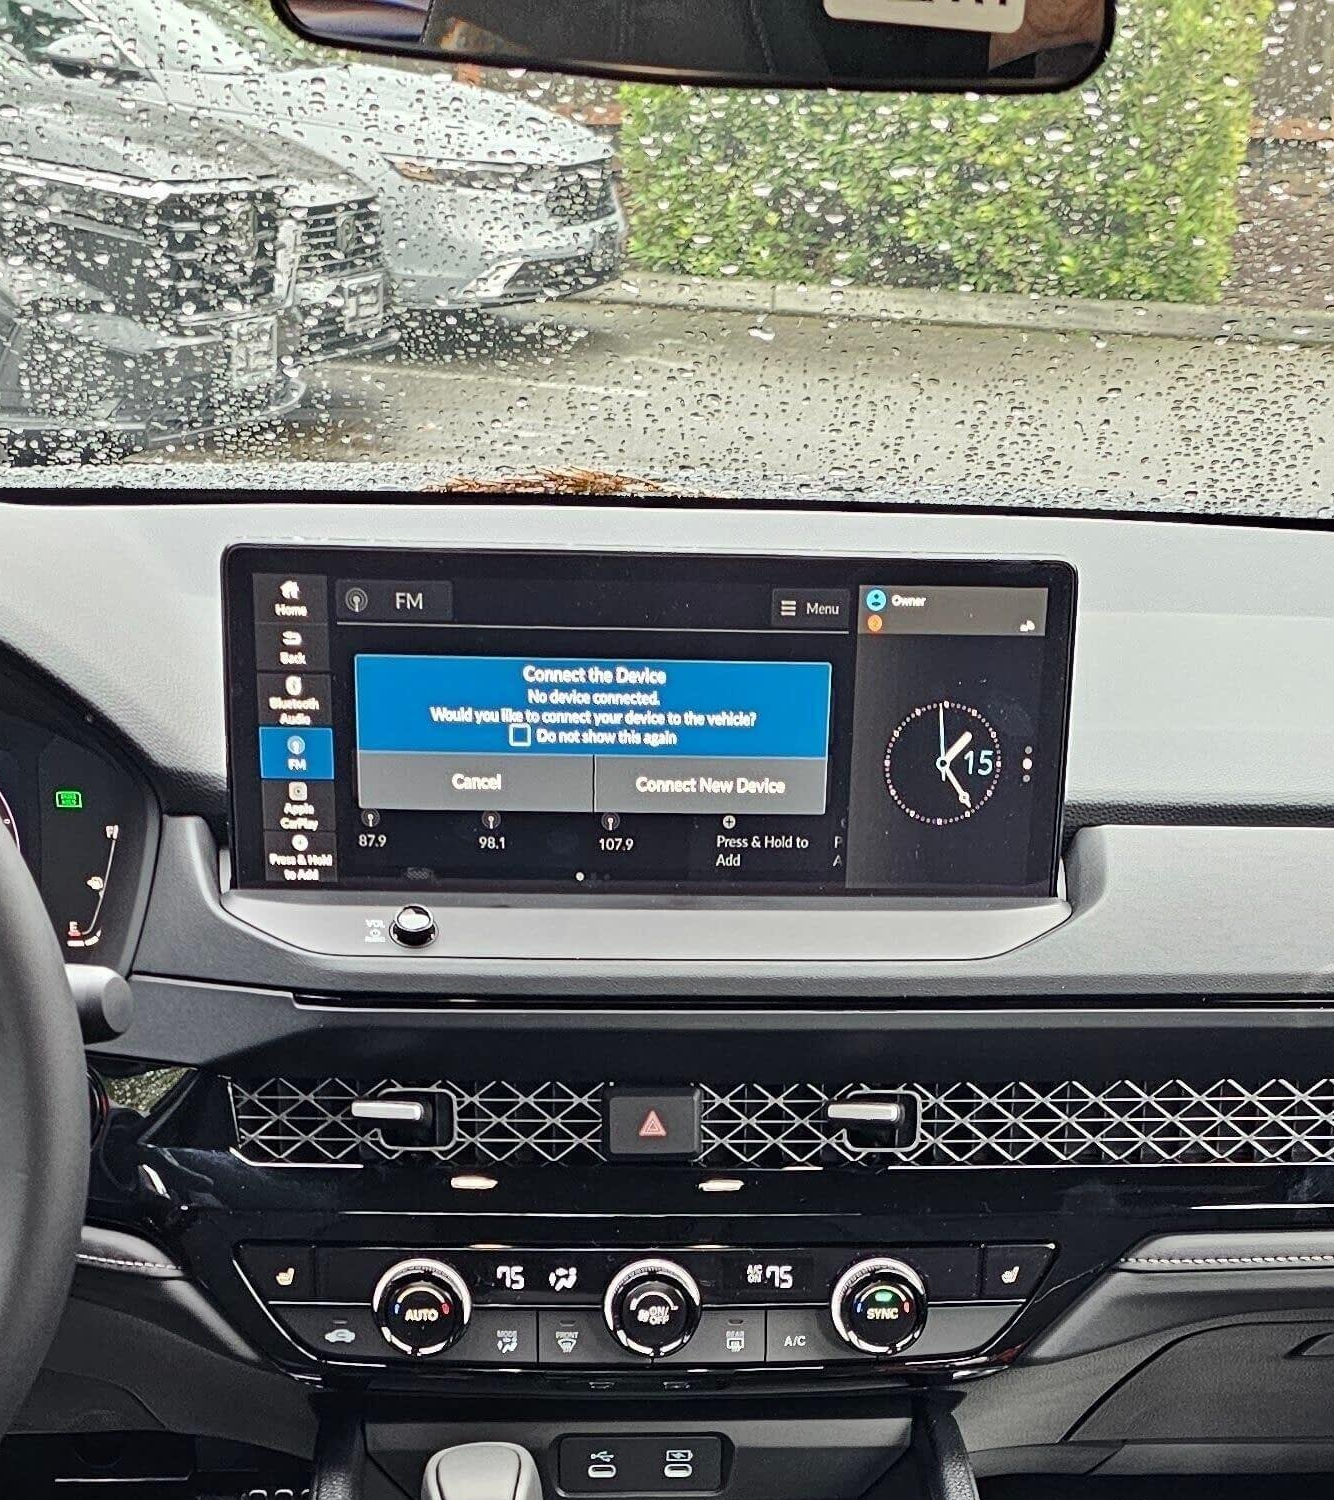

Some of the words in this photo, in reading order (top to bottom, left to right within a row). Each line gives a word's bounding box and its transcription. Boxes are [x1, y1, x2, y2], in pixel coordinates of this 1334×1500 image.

[396, 592, 424, 610] FM
[891, 594, 926, 607] Owner
[275, 604, 307, 617] Home
[806, 602, 839, 615] Menu
[280, 652, 306, 665] Back
[523, 665, 586, 683] Connect
[587, 666, 613, 684] the
[616, 666, 667, 684] Device
[269, 697, 320, 711] Bluetooth
[527, 689, 547, 703] No
[549, 689, 591, 704] device
[592, 691, 660, 706] connected.
[279, 713, 311, 726] Audio
[430, 706, 473, 722] Would
[474, 710, 499, 724] you
[500, 708, 524, 723] like
[525, 709, 540, 723] to
[542, 710, 592, 724] connect
[593, 712, 623, 726] your
[625, 710, 665, 725] device
[667, 711, 681, 725] to
[684, 710, 705, 726] the
[707, 711, 757, 727] vehicle?
[536, 728, 556, 743] Do
[559, 729, 580, 743] not
[581, 729, 616, 744] show
[618, 730, 641, 744] this
[643, 731, 677, 746] again
[288, 759, 307, 771] FM
[964, 750, 994, 776] 15
[451, 773, 502, 790] Cancel
[635, 776, 697, 793] Connect
[699, 778, 733, 794] New
[736, 778, 786, 794] Device
[284, 803, 314, 817] Apple
[359, 834, 387, 847] 87.9
[479, 836, 505, 849] 98.1
[599, 838, 634, 851] 107.9
[717, 835, 748, 849] Press
[751, 837, 761, 849] &
[764, 836, 792, 849] Hold
[796, 837, 809, 849] to
[269, 853, 296, 866] Press
[308, 853, 332, 867] Hold
[716, 854, 741, 867] Add
[297, 869, 319, 881] Add
[496, 1265, 525, 1290] 75
[765, 1266, 793, 1290] 75
[405, 1308, 438, 1322] AUTO
[867, 1307, 899, 1320] SYNC
[784, 1335, 806, 1347] A/C
